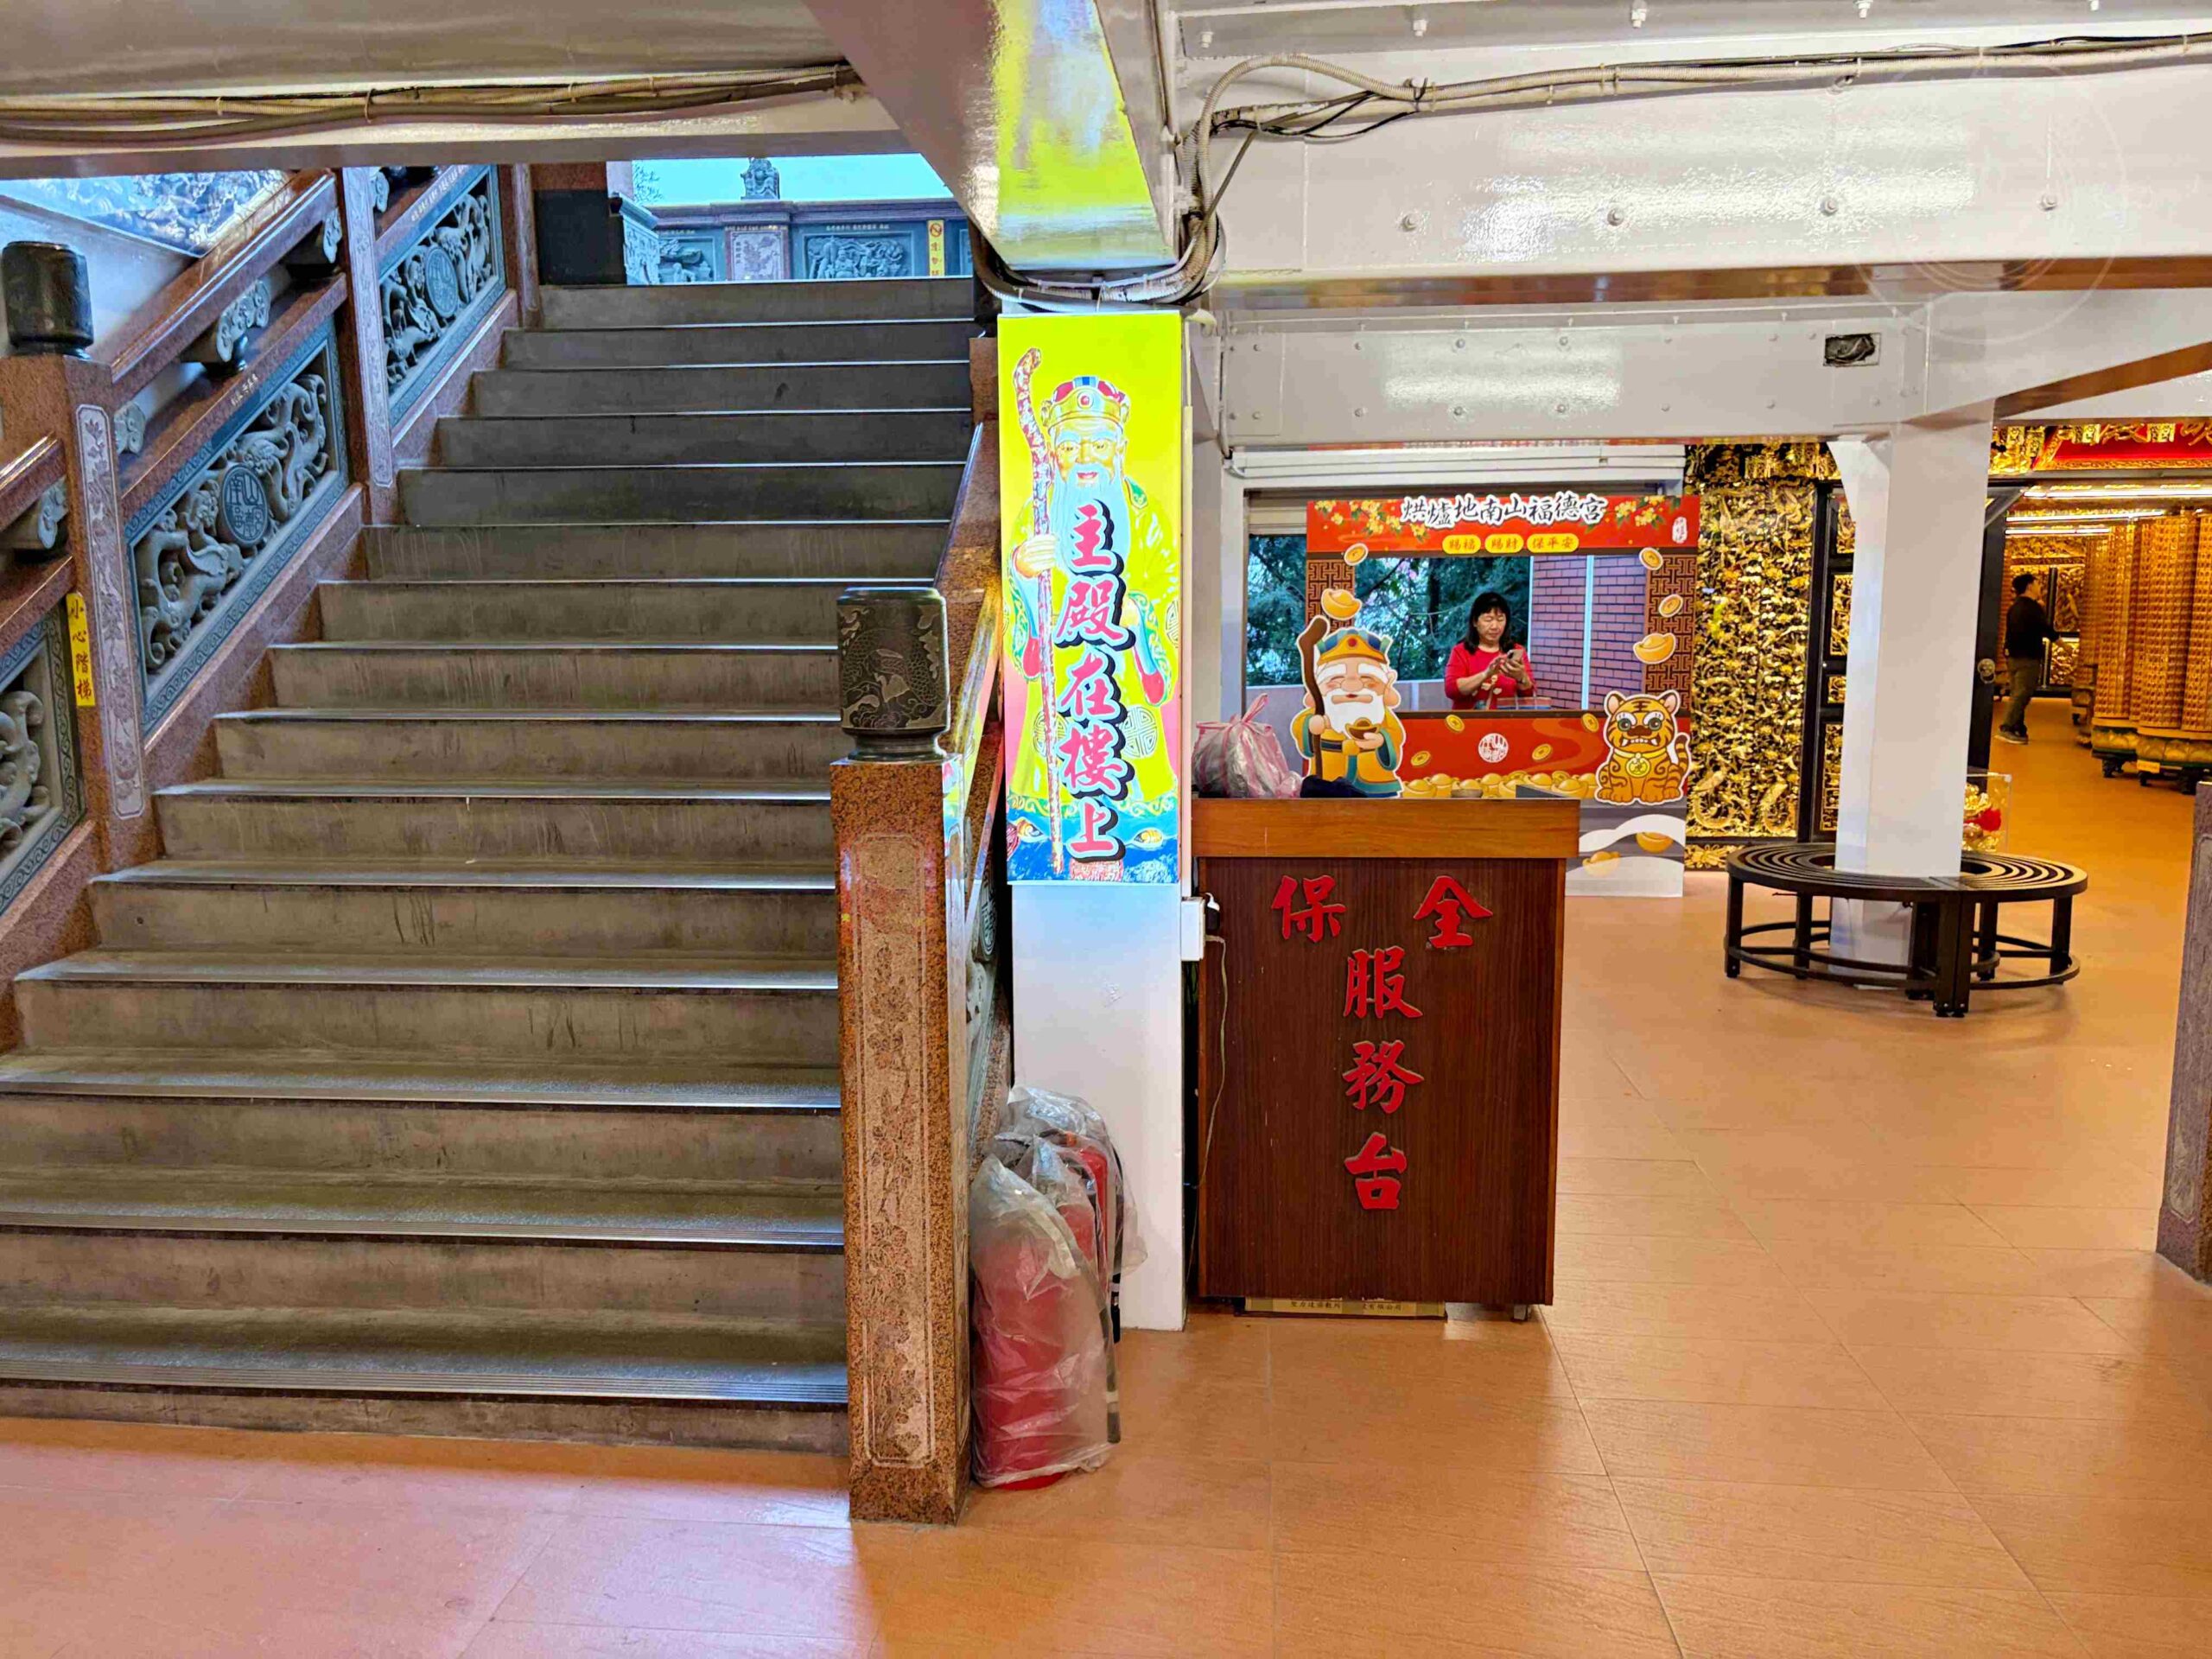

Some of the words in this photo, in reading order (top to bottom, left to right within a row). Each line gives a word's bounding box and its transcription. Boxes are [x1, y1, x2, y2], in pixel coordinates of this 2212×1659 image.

[1402, 495, 1605, 525] 烘爐地南山福德宮
[1532, 537, 1574, 550] 保平安
[69, 599, 92, 700] 小心階梯
[1055, 501, 1132, 861] 主殿在樓上
[1341, 945, 1425, 1210] 服務台
